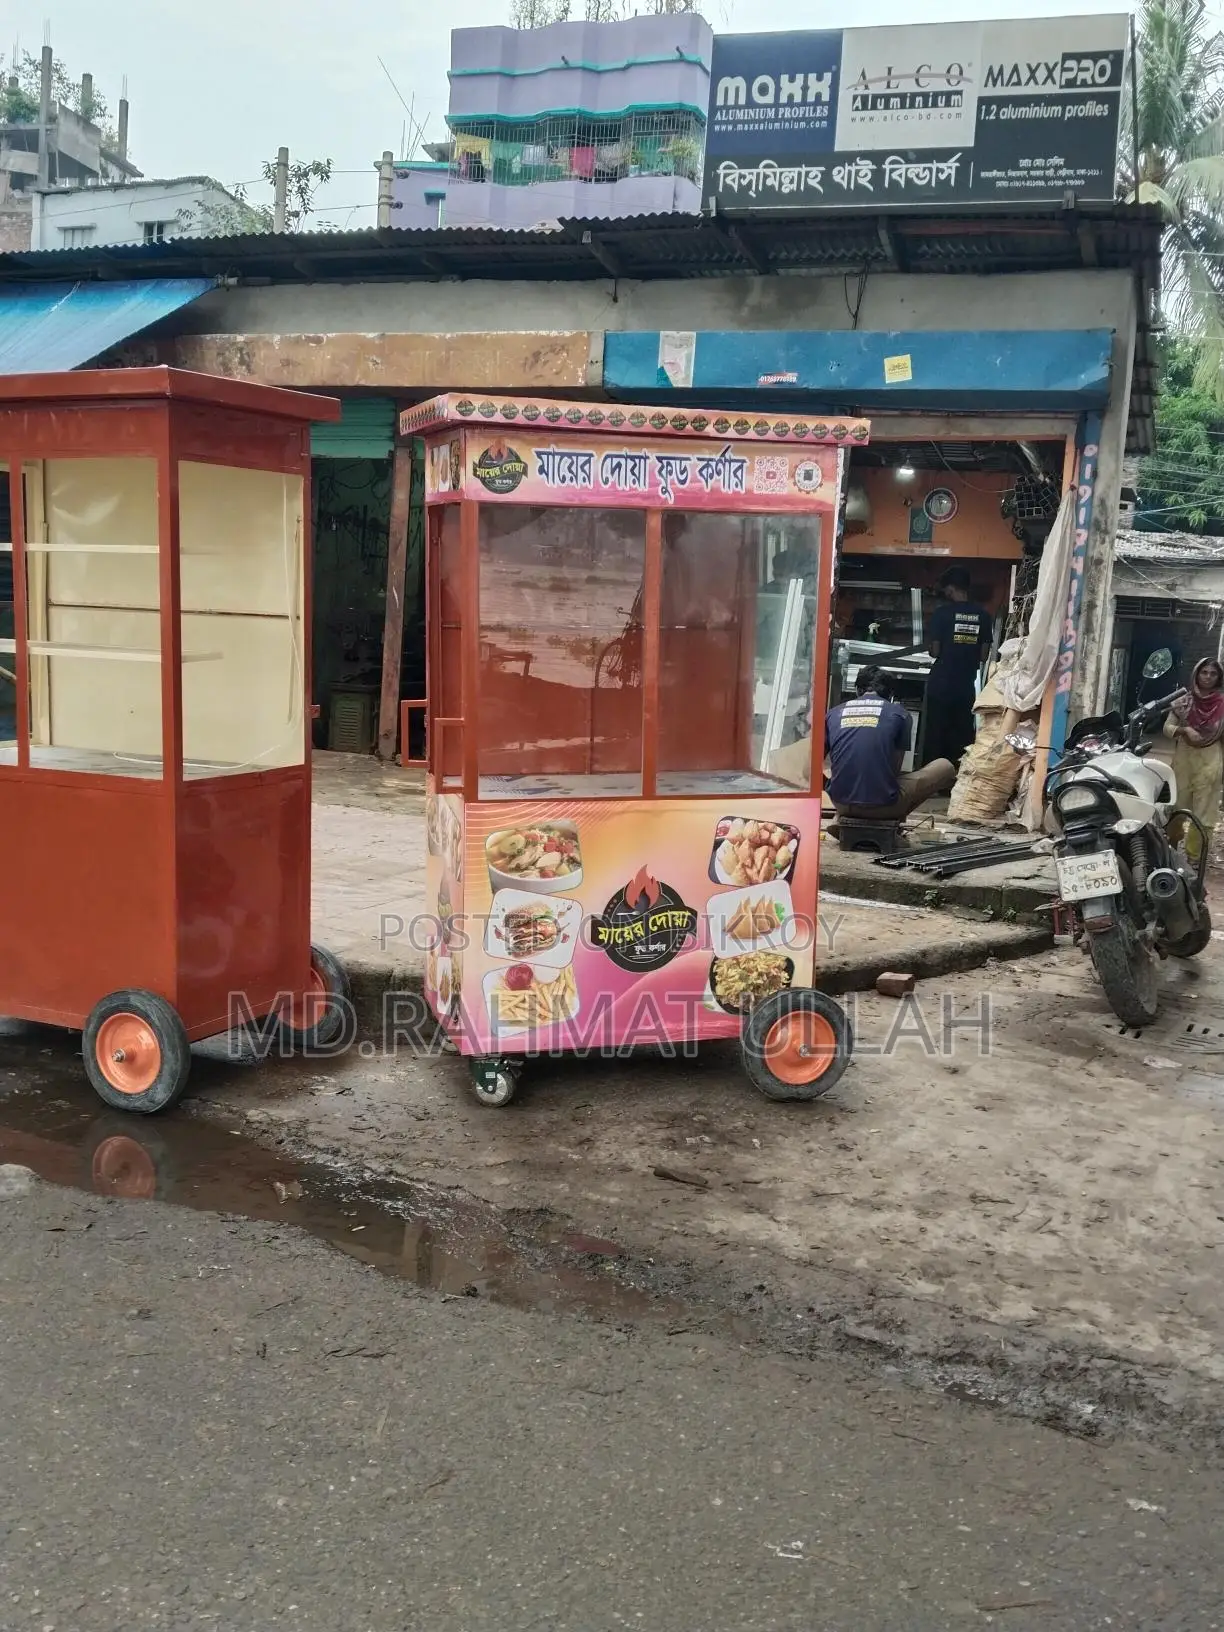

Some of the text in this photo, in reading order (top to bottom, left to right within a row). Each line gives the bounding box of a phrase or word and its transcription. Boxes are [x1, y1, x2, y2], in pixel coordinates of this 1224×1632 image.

[854, 63, 964, 90] ALCO
[853, 92, 962, 110] Aluminium
[980, 101, 1109, 121] 1.2 aluminium profiles
[715, 106, 829, 121] ALUMINIUM PROFILES
[851, 112, 962, 123] www.alco-bd.com
[714, 121, 828, 132] www.maxxaluminium.com
[832, 157, 877, 192] থাই
[882, 153, 963, 189] বিল্ডার্স
[533, 444, 747, 503] মায়ের দোয়া ফুড কর্ণার
[597, 910, 691, 945] মায়ের দোয়া
